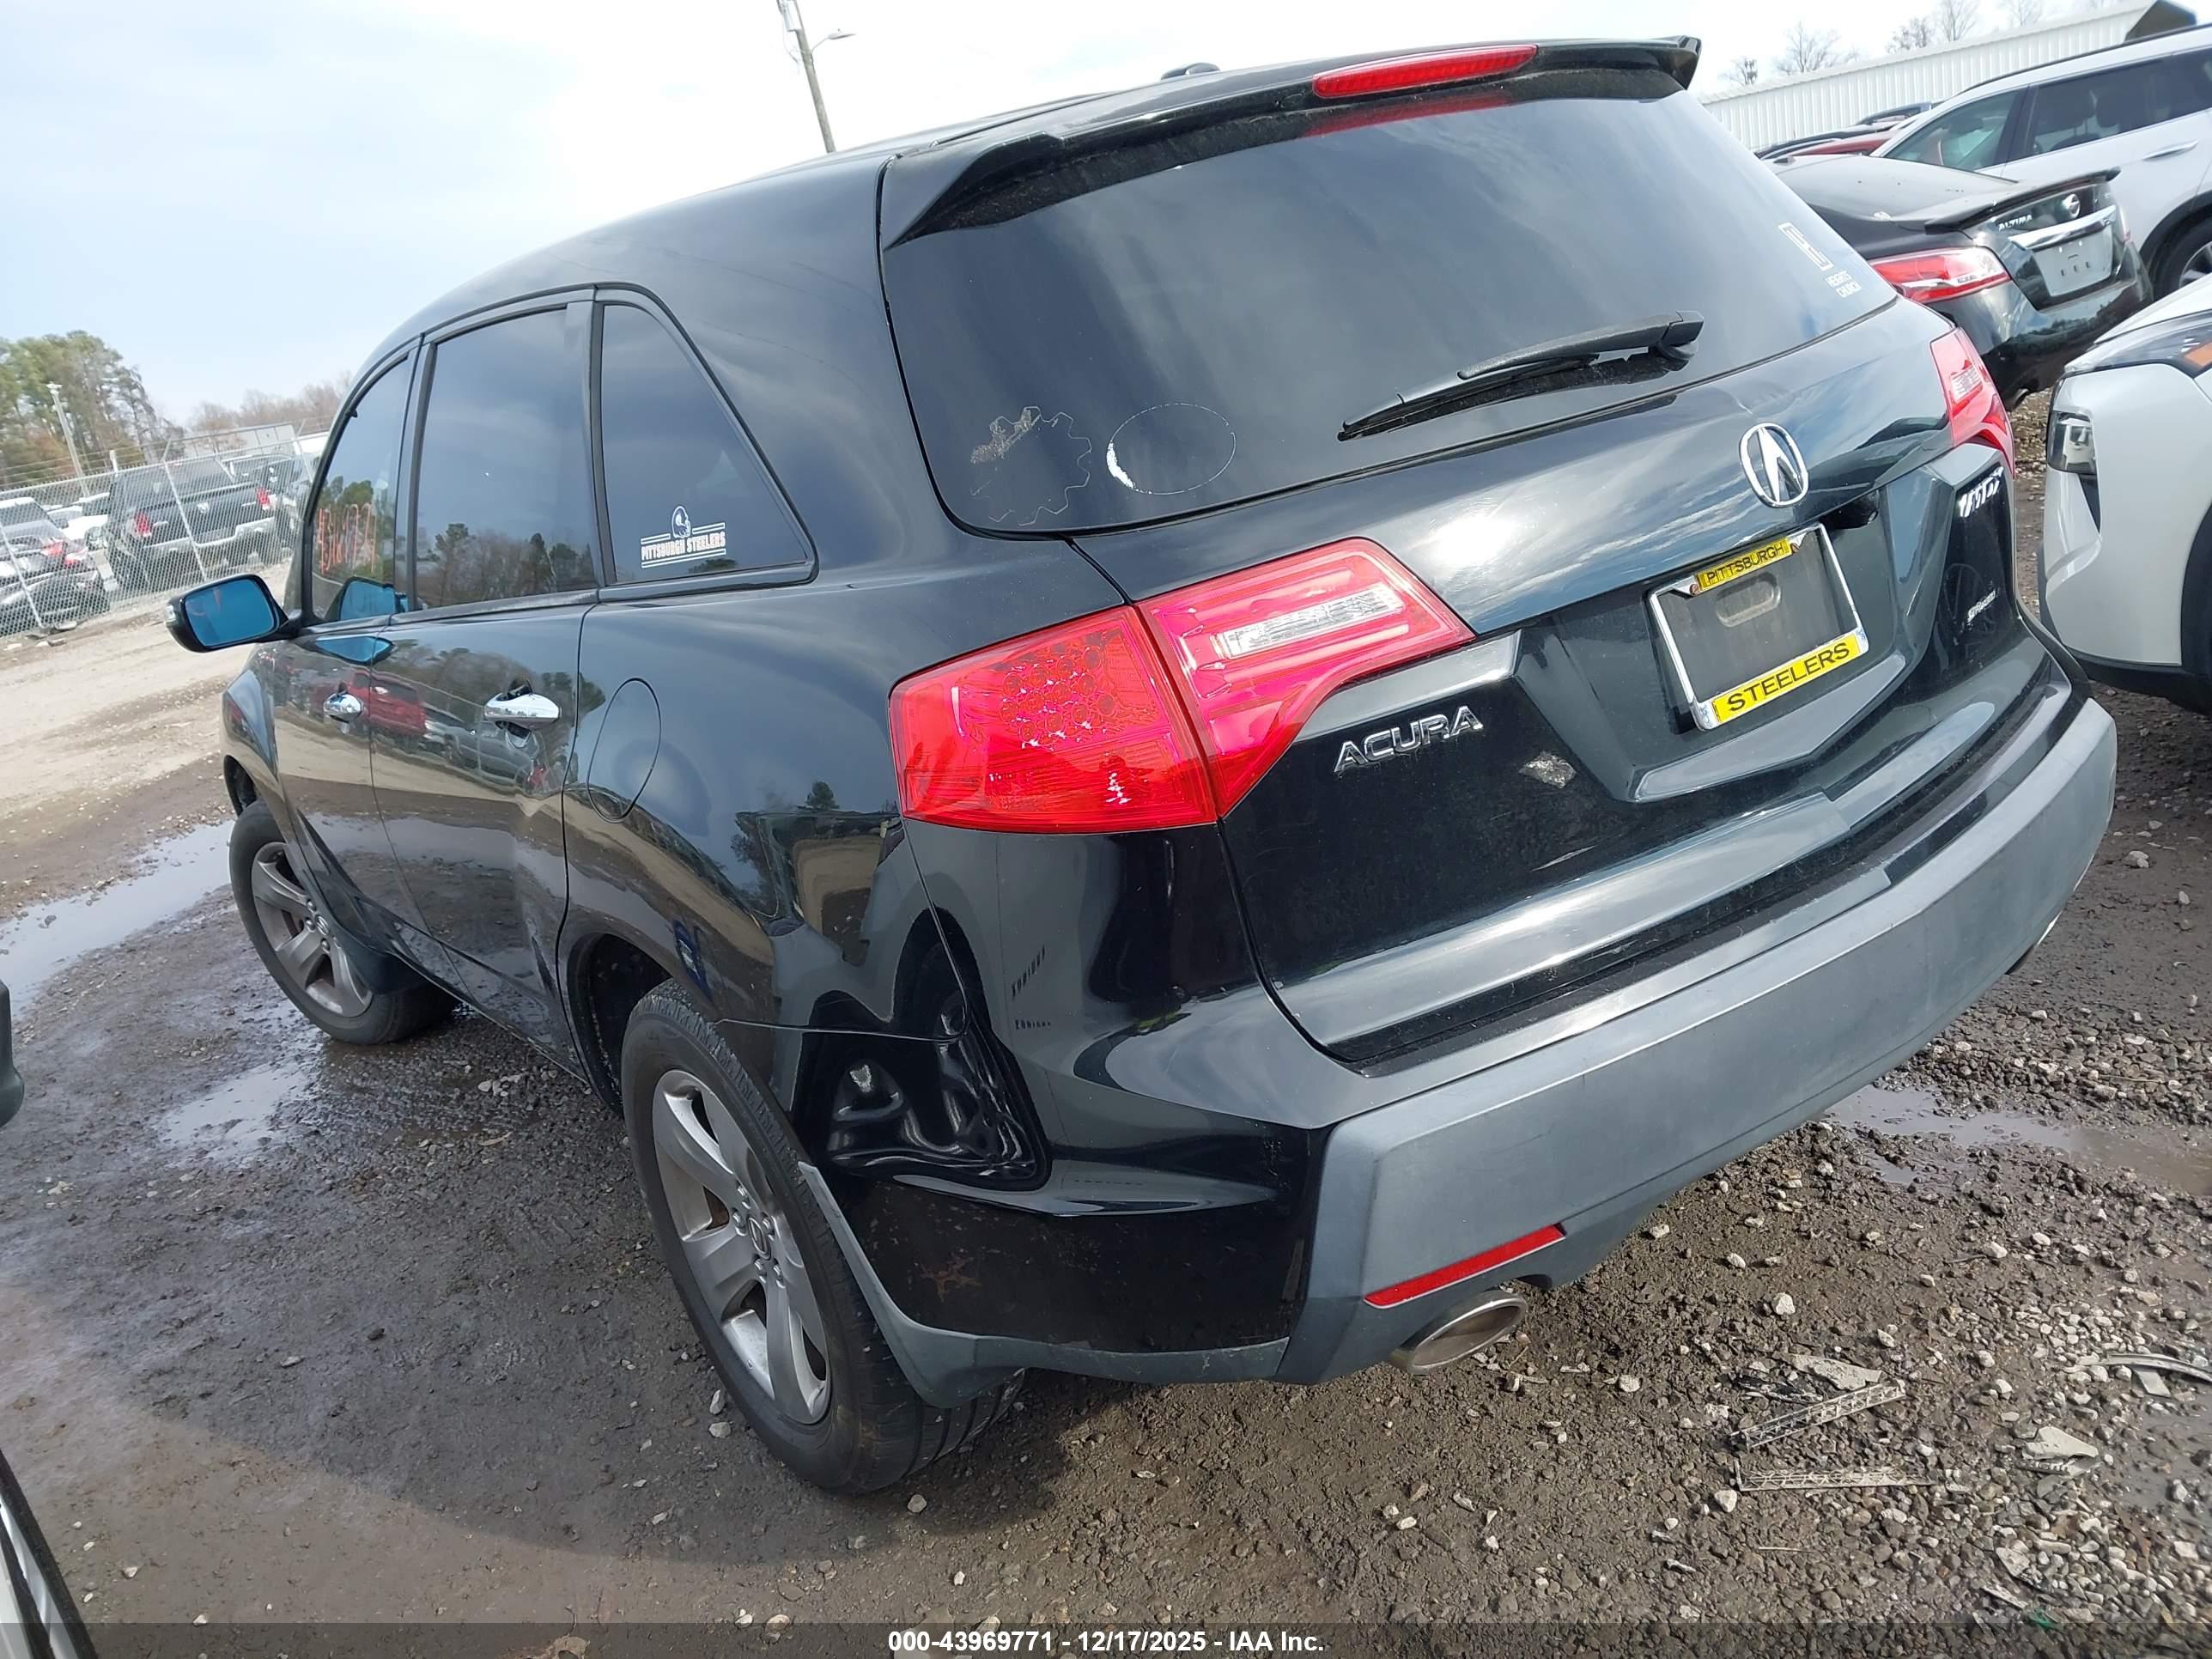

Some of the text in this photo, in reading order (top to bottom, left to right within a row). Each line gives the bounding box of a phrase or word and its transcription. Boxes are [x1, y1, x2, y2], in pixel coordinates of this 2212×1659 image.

[1998, 214, 2033, 232] ALTIMA
[641, 531, 726, 562] PITTSBURGH STEELERS
[1706, 543, 1784, 586] PITTSBURGH
[1727, 641, 1850, 712] STEELERS
[1333, 705, 1484, 774] ACURA
